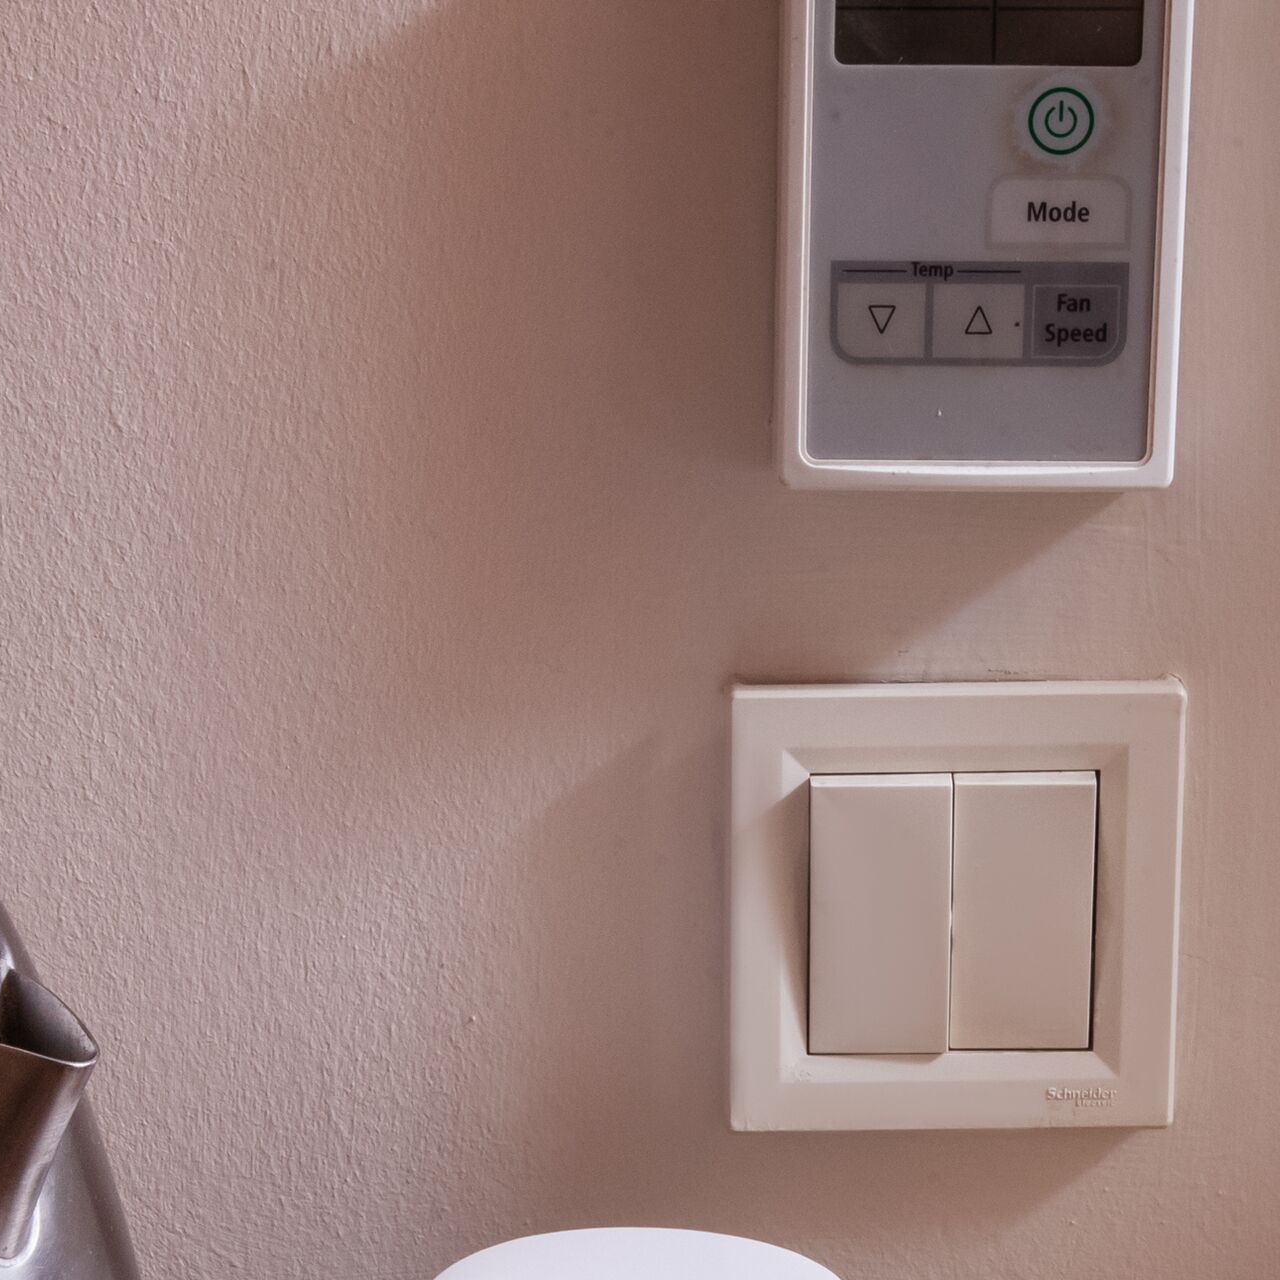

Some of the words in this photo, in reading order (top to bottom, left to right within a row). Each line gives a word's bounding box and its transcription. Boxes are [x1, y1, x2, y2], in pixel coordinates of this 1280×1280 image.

[1027, 202, 1090, 224] Mode
[912, 262, 954, 281] Temp
[1057, 294, 1091, 312] Fan
[1045, 323, 1108, 347] Speed
